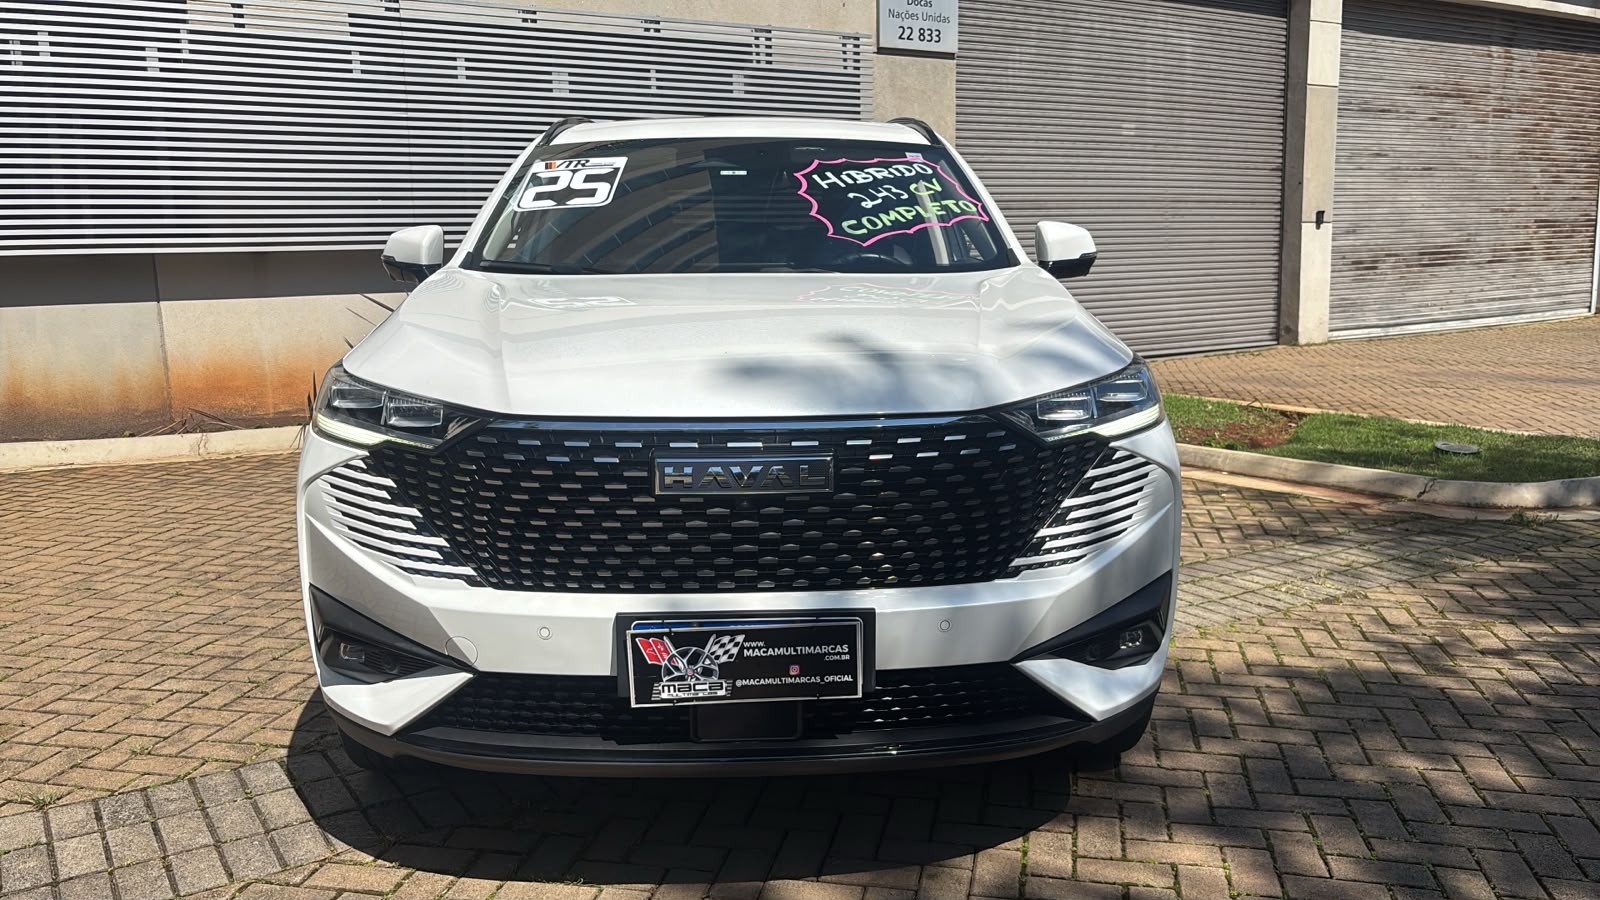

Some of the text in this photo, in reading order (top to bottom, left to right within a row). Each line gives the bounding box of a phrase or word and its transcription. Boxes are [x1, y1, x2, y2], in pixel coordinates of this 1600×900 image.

[888, 8, 951, 24] Nações Unidas
[898, 25, 941, 43] 22 833
[519, 168, 612, 208] 25
[847, 177, 943, 209] 243 CV
[841, 199, 978, 235] COMPLETO
[664, 465, 826, 488] HAVAL
[743, 644, 849, 657] MACAMULTIMARCAS
[735, 675, 854, 688] @MACAMULTIMARCAS_OFICIAL
